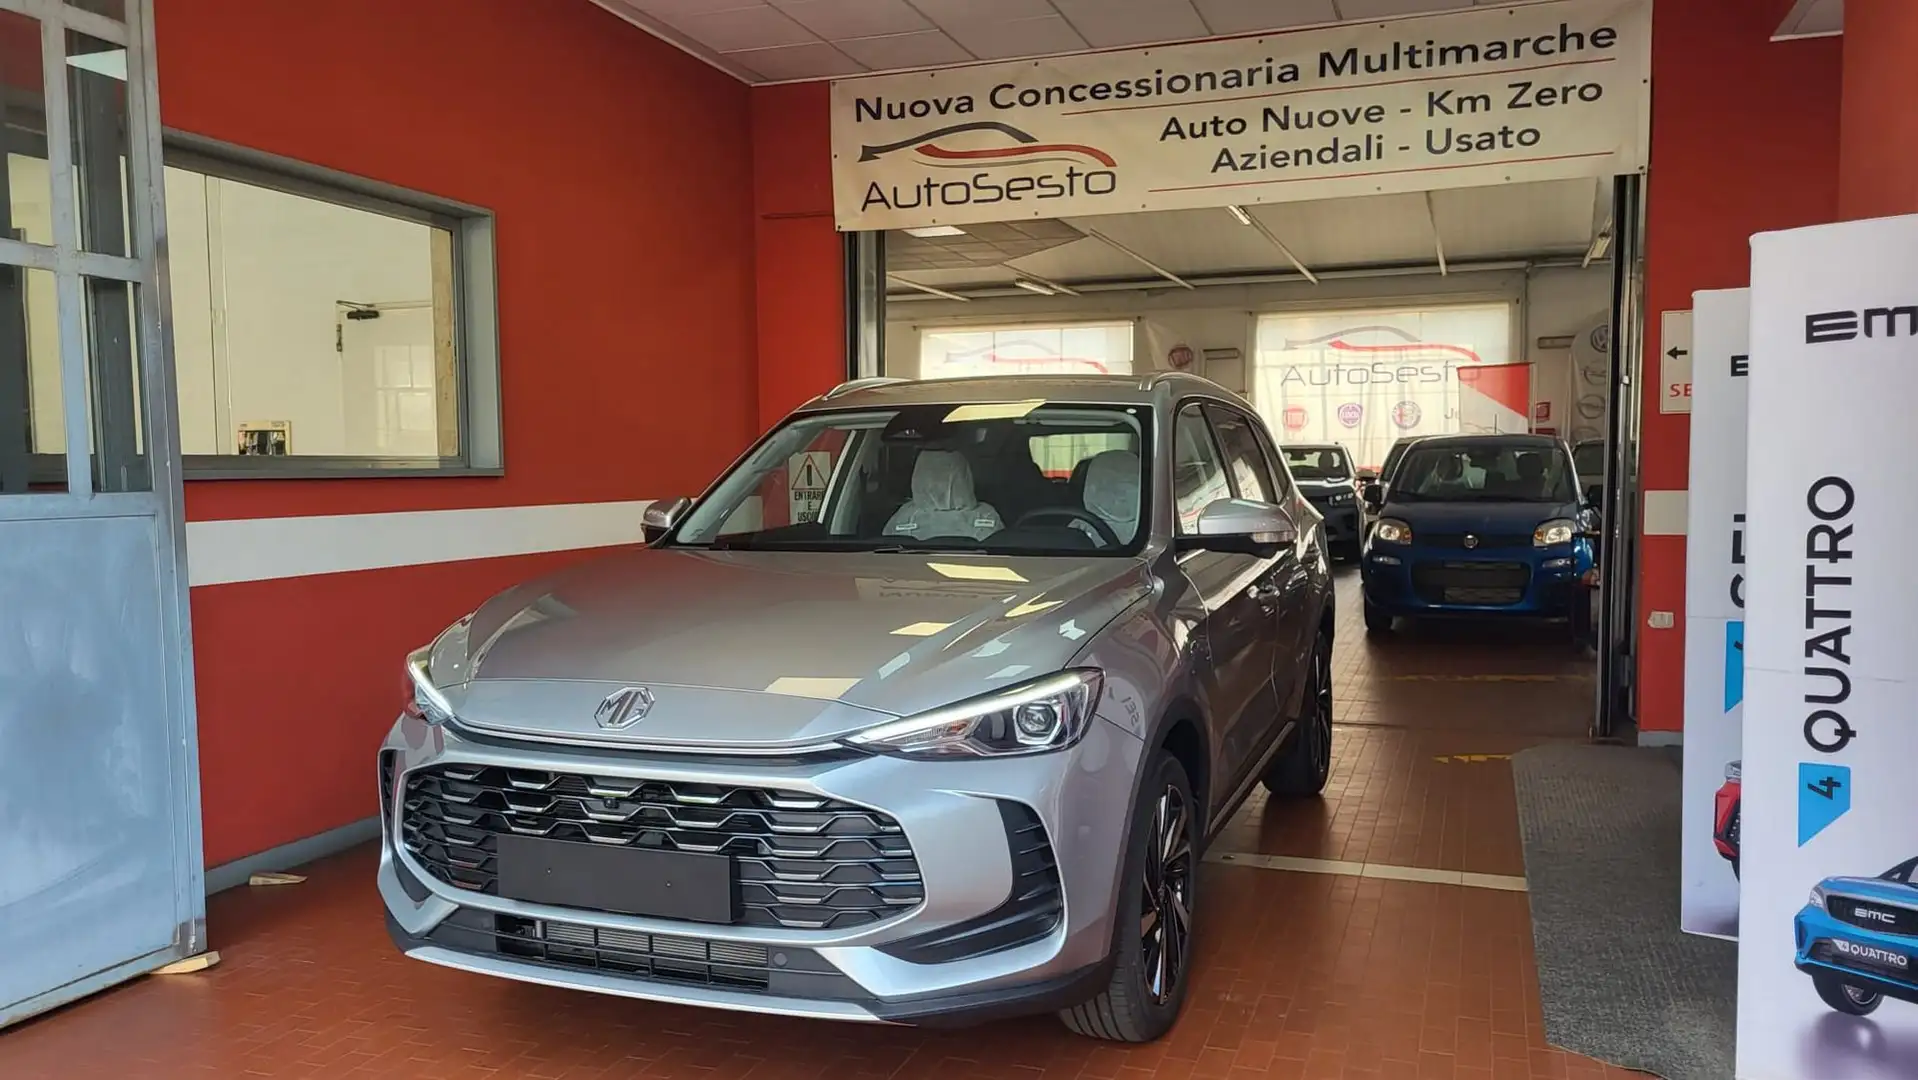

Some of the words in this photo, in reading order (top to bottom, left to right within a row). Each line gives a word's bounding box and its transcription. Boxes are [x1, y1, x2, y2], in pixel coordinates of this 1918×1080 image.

[855, 95, 974, 122] Nuova
[989, 57, 1299, 110] Concessionaria
[1318, 23, 1617, 78] Multimarche
[1159, 115, 1247, 141] Auto
[1262, 104, 1385, 132] Nuove
[1427, 89, 1491, 117] Km
[1507, 81, 1603, 109] Zero
[1211, 134, 1383, 173] Aziendali
[1426, 125, 1541, 155] Usato
[861, 166, 1117, 212] AutoSesto
[1281, 360, 1481, 387] AutoSesto
[1803, 476, 1856, 753] QUATTRO
[595, 688, 653, 729] MG
[1807, 776, 1841, 800] 4
[1850, 945, 1907, 966] QUATTRO
